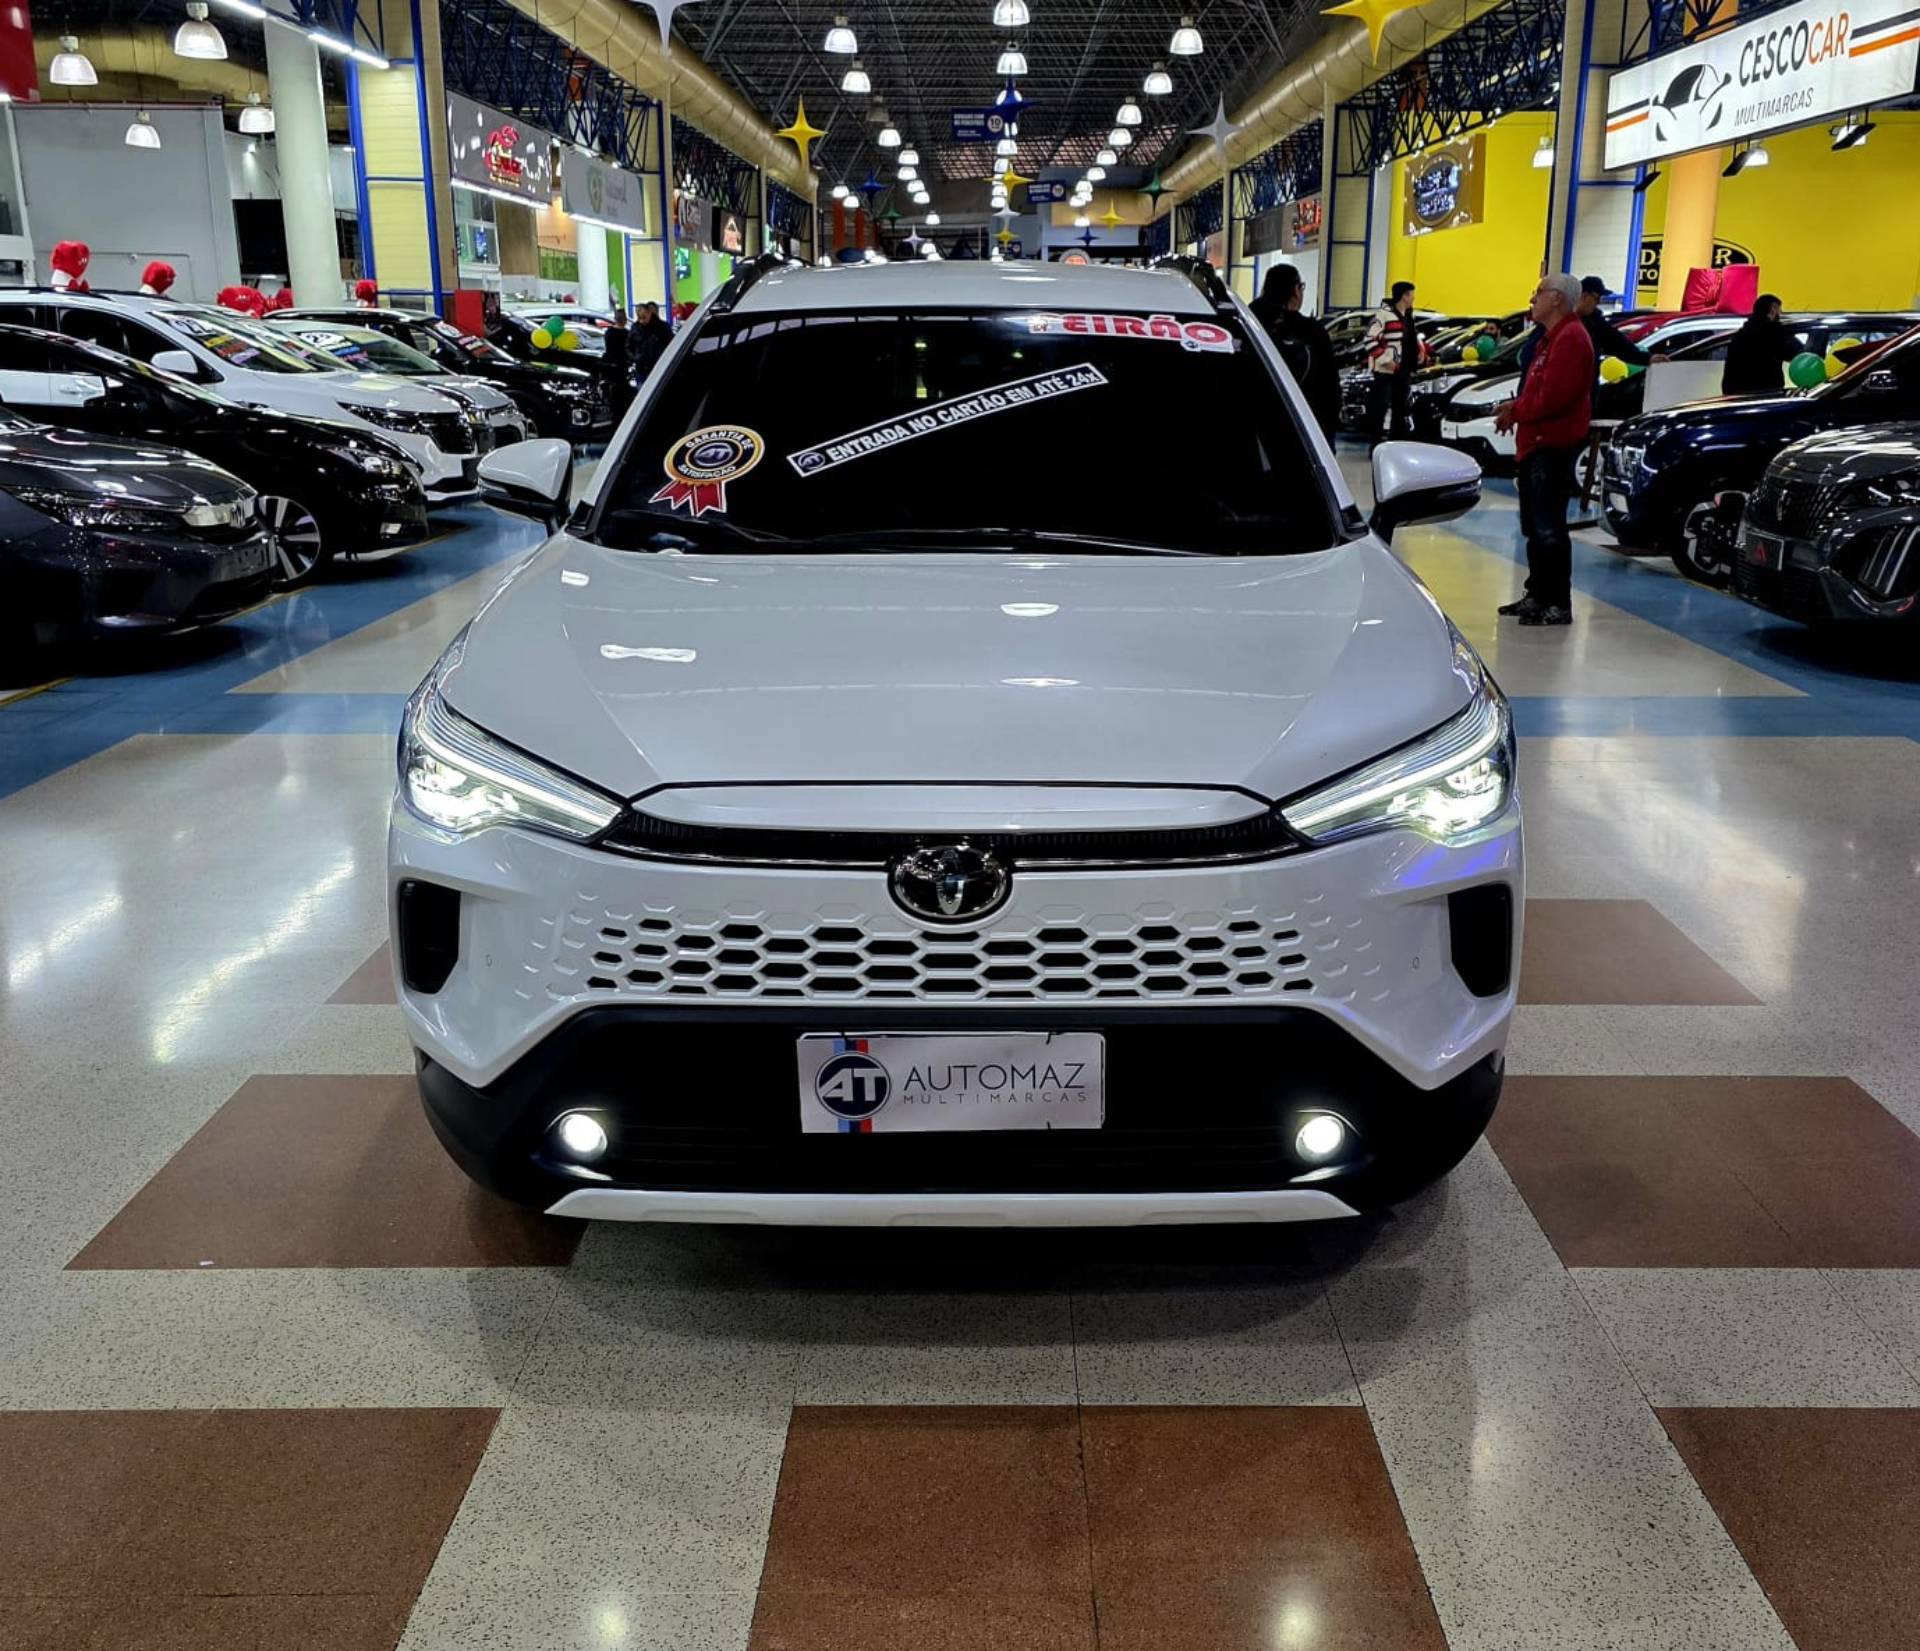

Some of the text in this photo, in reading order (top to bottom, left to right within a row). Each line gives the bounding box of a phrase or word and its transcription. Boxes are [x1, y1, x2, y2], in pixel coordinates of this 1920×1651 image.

[1739, 12, 1849, 87] CESCOCAR
[1734, 87, 1814, 127] MULTIMARCAS
[826, 424, 911, 462] ENTRADA
[907, 415, 937, 433] NO
[937, 396, 1007, 424] CARTÃO
[1004, 385, 1034, 402] EM
[1034, 376, 1068, 396] ATÉ
[1066, 371, 1101, 387] 24x
[685, 431, 744, 448] GARANTIA
[818, 1063, 1086, 1102] AT AUTOMAZ
[904, 1092, 1088, 1105] MULTIMARCAS
